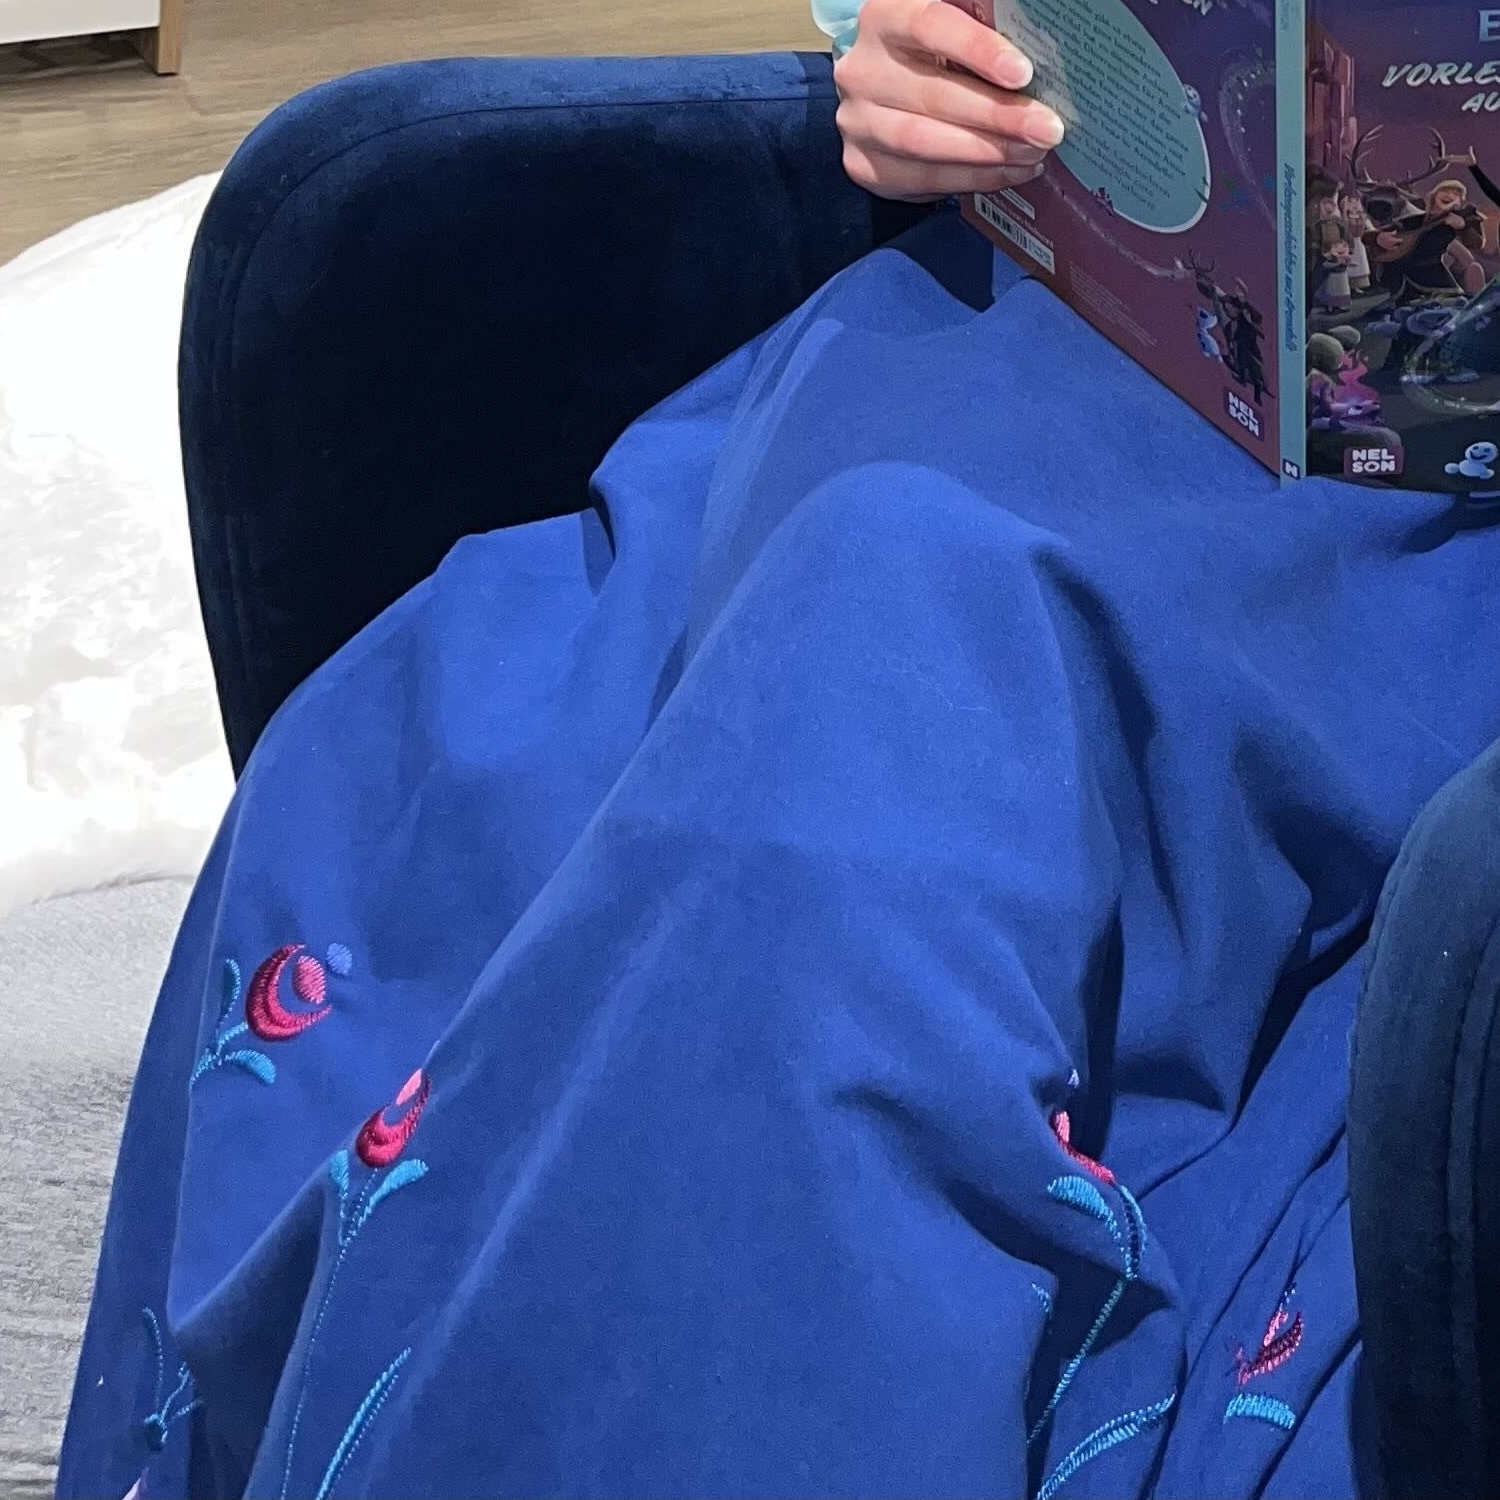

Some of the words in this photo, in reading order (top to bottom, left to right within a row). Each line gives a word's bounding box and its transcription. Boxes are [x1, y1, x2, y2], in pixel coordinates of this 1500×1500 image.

[1228, 391, 1260, 426] NEL
[1228, 404, 1260, 438] SON
[1352, 448, 1395, 461] NEL
[1352, 461, 1396, 474] SON
